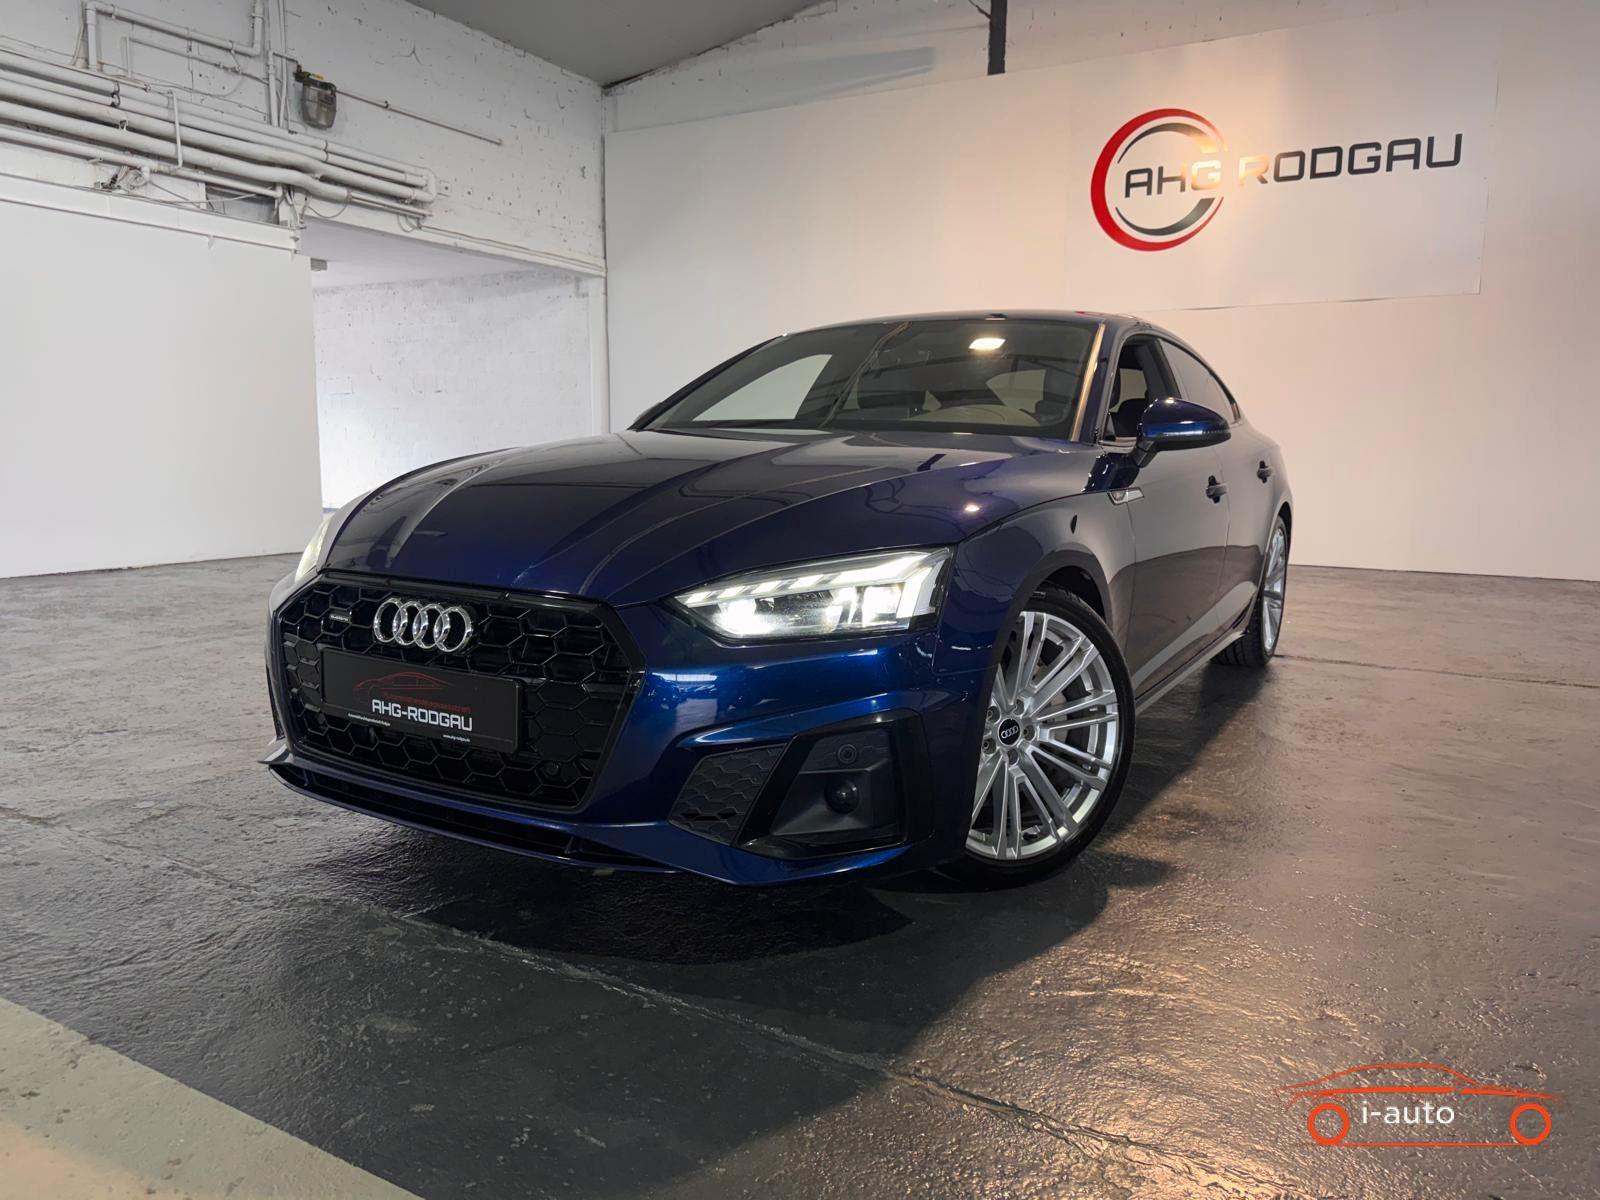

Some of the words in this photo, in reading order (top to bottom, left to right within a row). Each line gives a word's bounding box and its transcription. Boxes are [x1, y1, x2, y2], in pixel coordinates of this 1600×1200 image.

[1124, 158, 1223, 199] AHG
[1237, 133, 1463, 186] RODGAU
[371, 698, 473, 732] AHG-RODGAU
